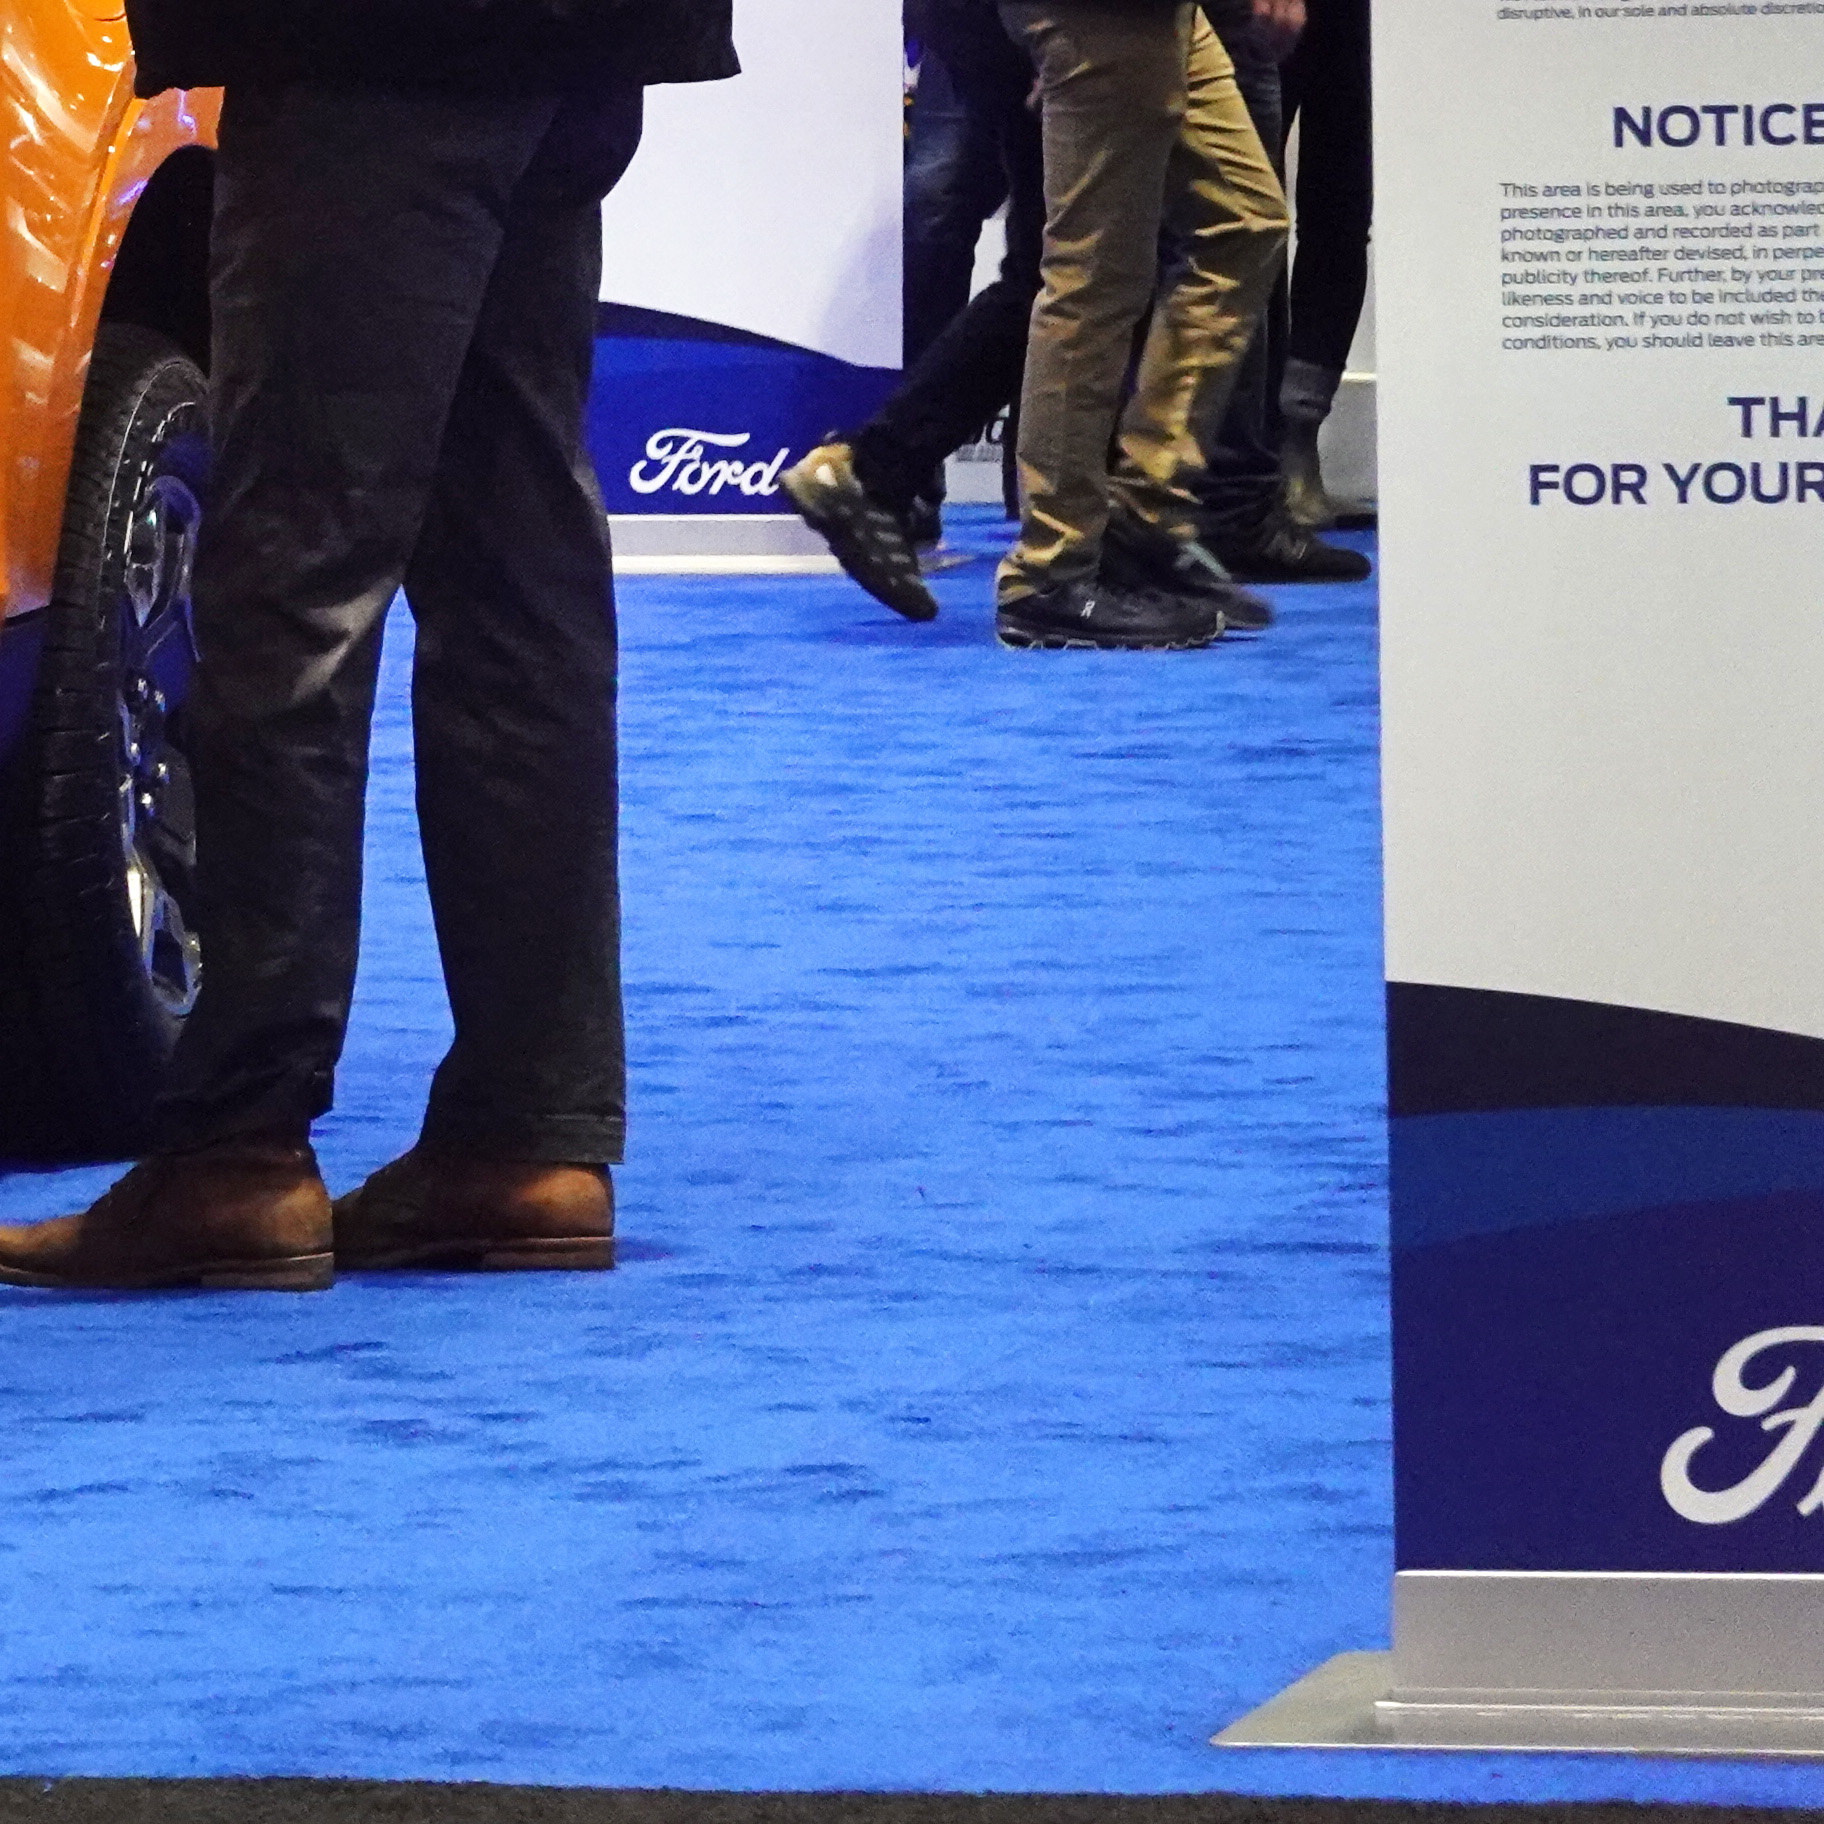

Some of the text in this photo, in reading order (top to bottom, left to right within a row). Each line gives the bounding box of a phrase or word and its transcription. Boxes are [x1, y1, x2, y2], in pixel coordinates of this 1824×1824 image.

[1613, 104, 1824, 148] NOTICE
[1500, 183, 1539, 198] This
[1542, 185, 1582, 197] area
[1586, 182, 1601, 197] is
[1604, 182, 1655, 199] being
[1658, 181, 1704, 196] used
[1707, 181, 1727, 195] to
[1500, 207, 1583, 222] presence
[1586, 204, 1603, 218] in
[1607, 203, 1641, 218] this
[1693, 205, 1726, 219] you
[1500, 223, 1820, 243] photographed and recorded as part
[1500, 248, 1562, 263] known
[1565, 250, 1583, 262] or
[1588, 247, 1670, 262] hereafter
[1752, 246, 1769, 260] in
[1501, 269, 1578, 287] publicity
[1731, 267, 1753, 284] by
[1756, 270, 1796, 284] your
[1502, 291, 1574, 306] likeness
[1578, 290, 1613, 305] and
[1617, 290, 1664, 304] voice
[1668, 290, 1688, 304] to
[1691, 289, 1714, 304] be
[1718, 289, 1797, 303] included
[1649, 314, 1683, 329] you
[1686, 312, 1711, 326] do
[1714, 311, 1745, 326] not
[1750, 311, 1792, 325] wish
[1796, 311, 1816, 325] to
[1605, 337, 1638, 351] you
[1642, 334, 1704, 348] should
[1707, 333, 1756, 348] leave
[1759, 333, 1794, 347] this
[629, 428, 790, 496] Ford
[1529, 461, 1824, 506] FOR YOUR
